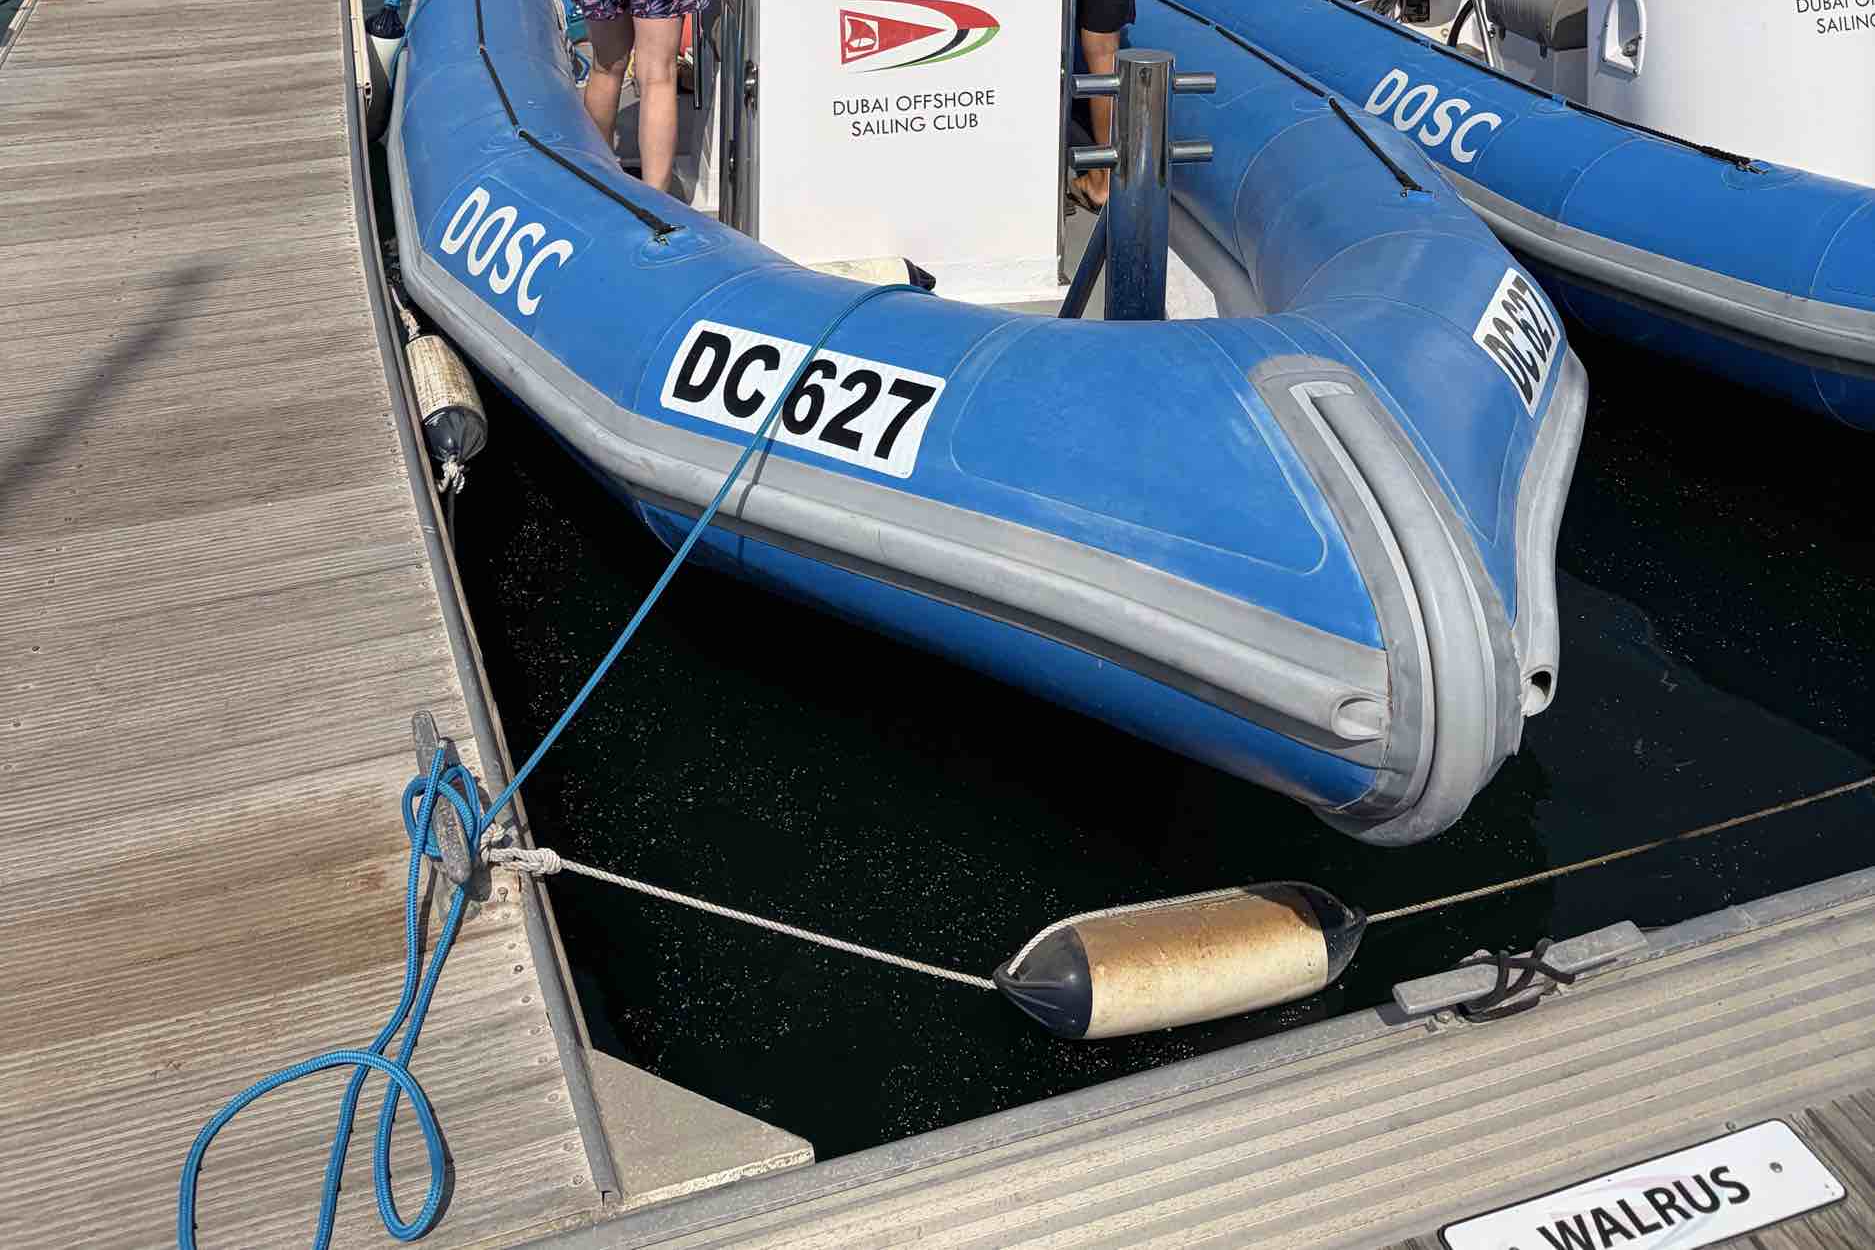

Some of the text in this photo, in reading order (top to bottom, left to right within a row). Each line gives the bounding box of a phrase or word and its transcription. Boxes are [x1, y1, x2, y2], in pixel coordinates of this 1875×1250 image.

[833, 89, 996, 117] DUBAI OFFSHORE
[850, 113, 979, 137] SAILING CLUB
[1363, 67, 1503, 164] DOSC
[438, 186, 574, 316] DOSC
[1483, 275, 1557, 405] DC 627
[672, 329, 936, 461] DC 627
[1535, 1165, 1751, 1250] WALRUS
